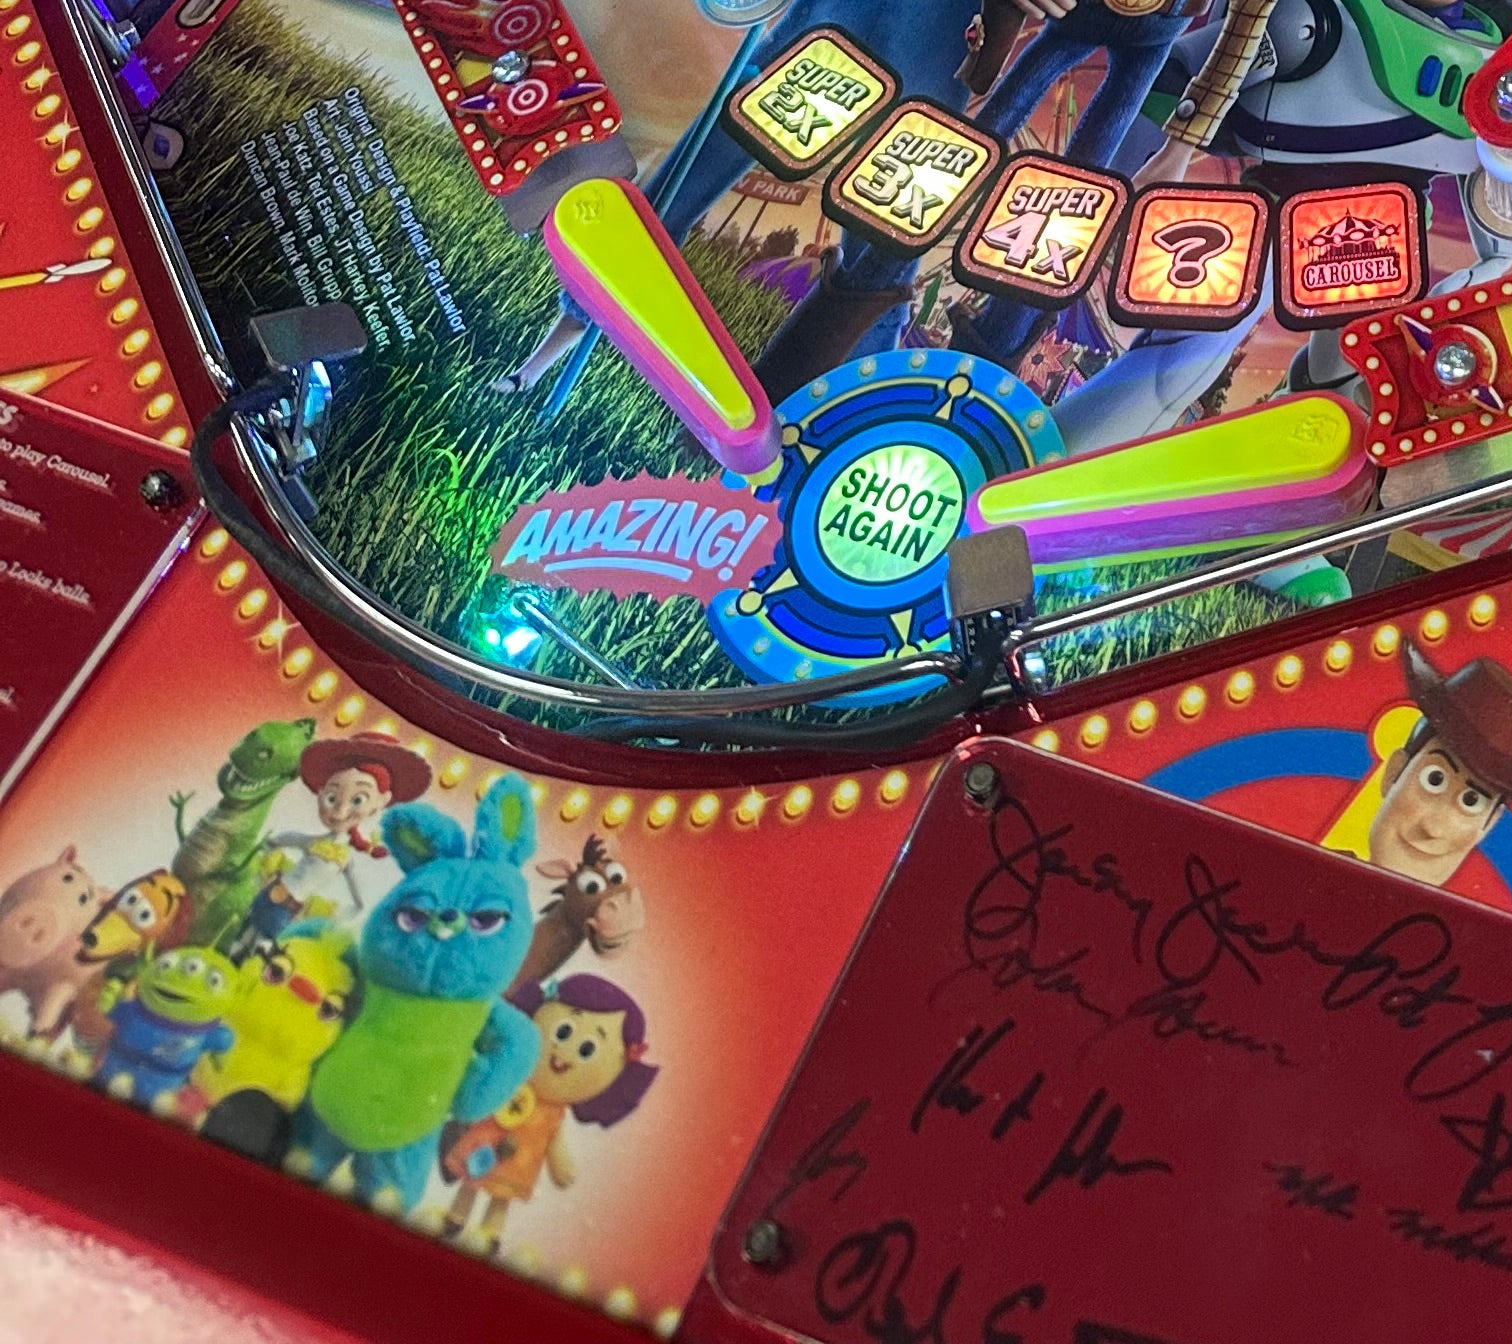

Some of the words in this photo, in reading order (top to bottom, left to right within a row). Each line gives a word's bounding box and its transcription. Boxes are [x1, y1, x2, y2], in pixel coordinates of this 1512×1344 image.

[786, 57, 871, 112] SUPER
[302, 107, 329, 147] Based
[344, 86, 377, 139] Original
[761, 81, 827, 146] 2X
[319, 145, 334, 164] on
[334, 121, 356, 154] John
[349, 151, 375, 197] Youssi
[367, 137, 398, 187] Design
[884, 130, 976, 178] SUPER
[240, 139, 267, 189] Duncan
[278, 229, 302, 267] Mark
[260, 130, 296, 193] Jean-Paul
[286, 188, 303, 208] de
[306, 233, 328, 261] Bill
[281, 120, 300, 144] Joe
[306, 172, 326, 201] Ted
[334, 238, 353, 254] JT
[332, 172, 357, 213] Game
[1006, 184, 1102, 220] SUPER
[348, 208, 377, 258] Design
[367, 252, 385, 275] by
[375, 271, 397, 301] Pat
[424, 258, 445, 288] Pat
[1304, 256, 1401, 291] CAROUSEL
[434, 283, 467, 334] Lawlor
[11, 444, 47, 469] play
[840, 467, 958, 529] SHOOT
[500, 497, 769, 582] AMAZING!
[822, 503, 935, 564] AGAIN
[8, 561, 53, 588] Locks
